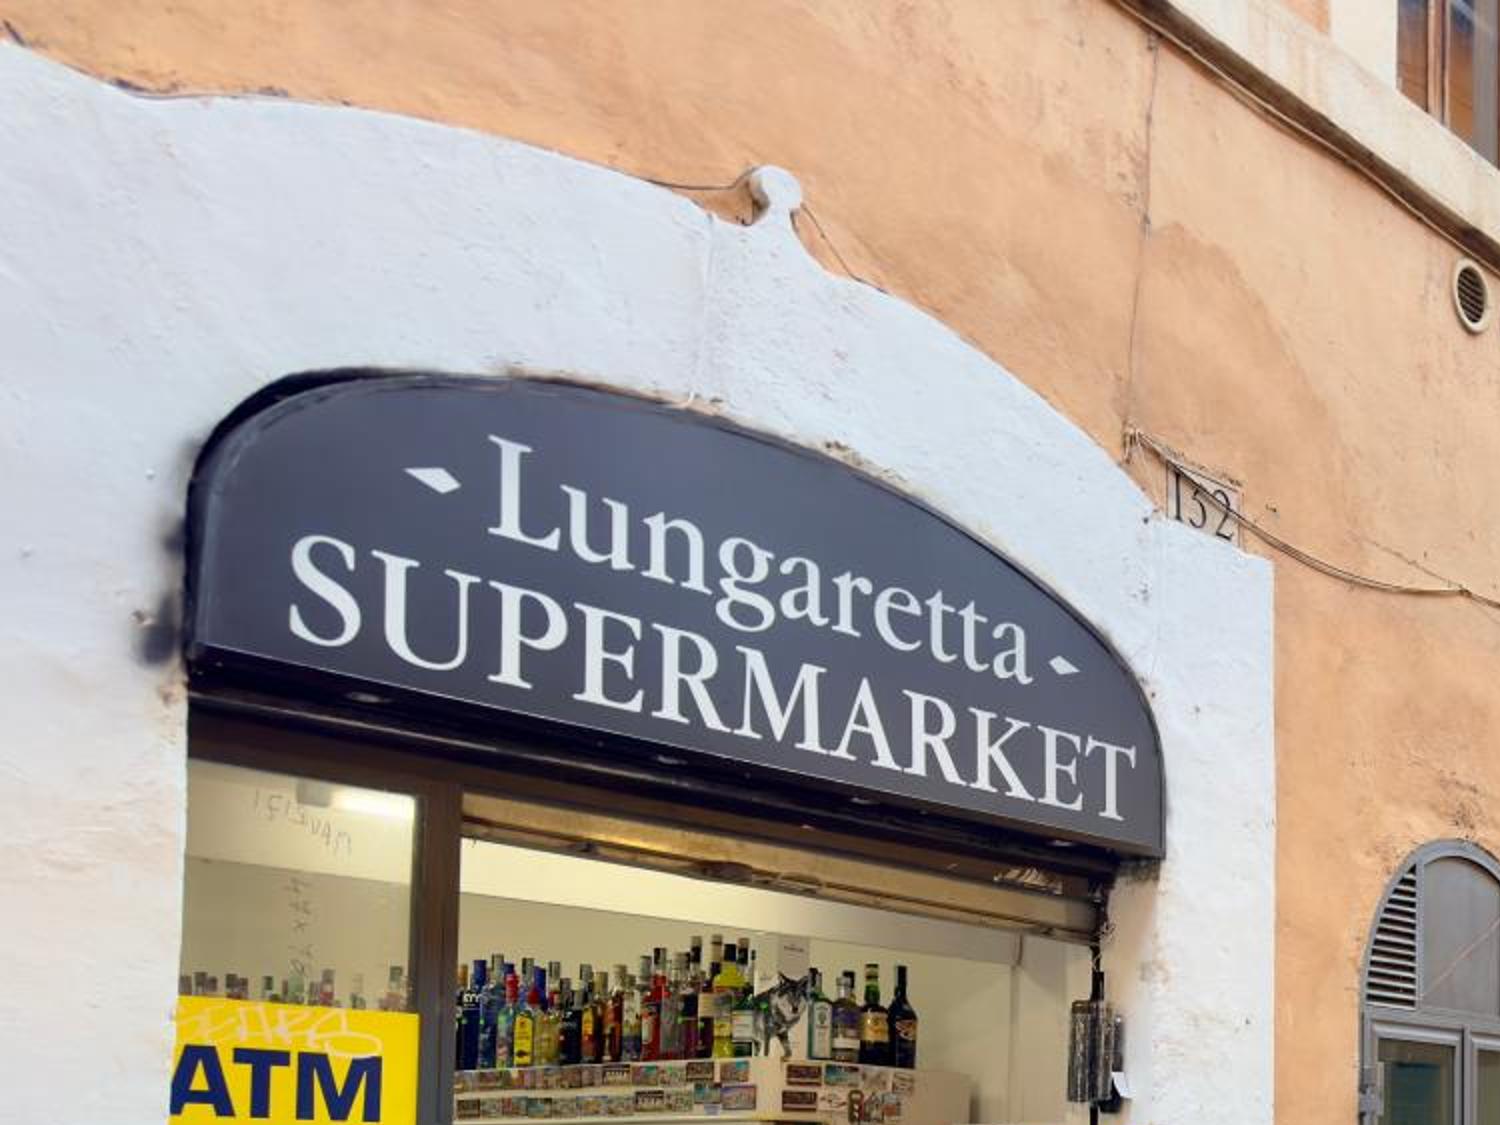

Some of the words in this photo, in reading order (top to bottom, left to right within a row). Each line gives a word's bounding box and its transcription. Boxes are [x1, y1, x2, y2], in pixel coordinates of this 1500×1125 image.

[487, 433, 1035, 686] Lungaretta
[1174, 470, 1233, 542] 152
[288, 534, 1137, 822] SUPERMARKET
[169, 1044, 383, 1123] ATM
